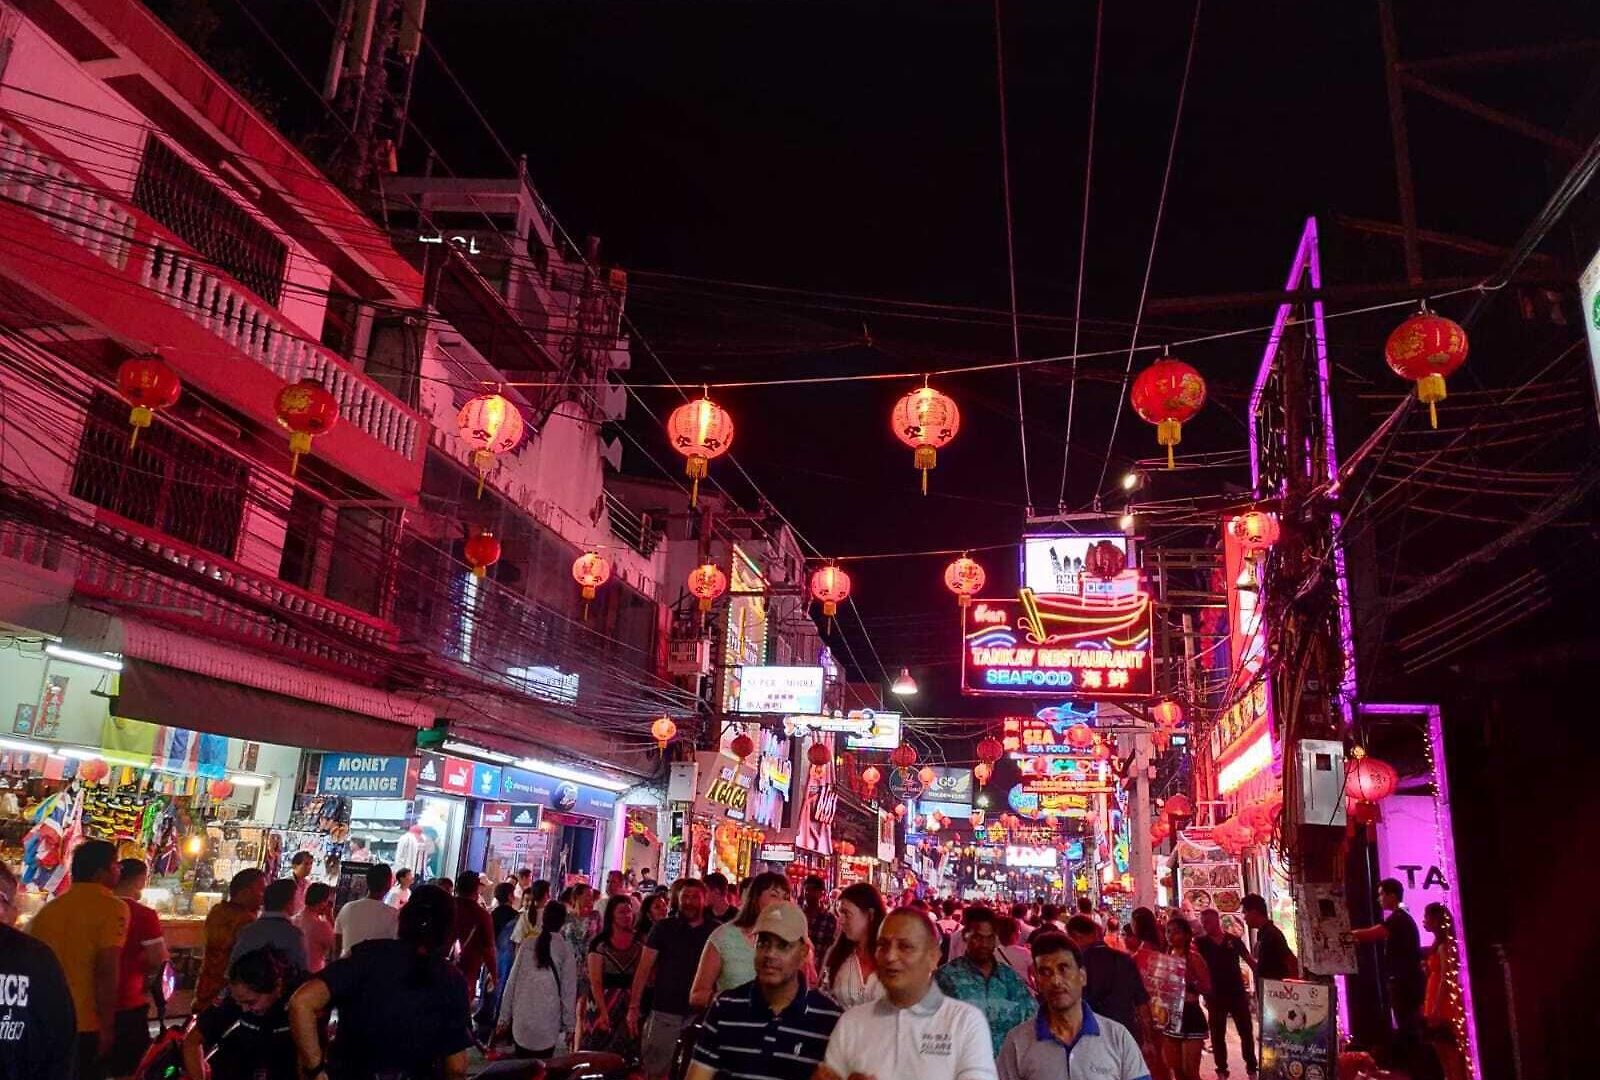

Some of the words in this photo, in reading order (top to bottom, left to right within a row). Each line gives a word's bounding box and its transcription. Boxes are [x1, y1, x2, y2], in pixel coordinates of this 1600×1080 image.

[971, 647, 1035, 666] TANKAY
[1037, 649, 1147, 668] RESTAURANT
[986, 669, 1073, 686] SEAFOOD
[1026, 745, 1044, 753] SEA
[1046, 745, 1070, 753] FOOD
[338, 757, 389, 772] MONEY
[325, 776, 399, 792] EXCHANGE
[1394, 865, 1450, 891] TA
